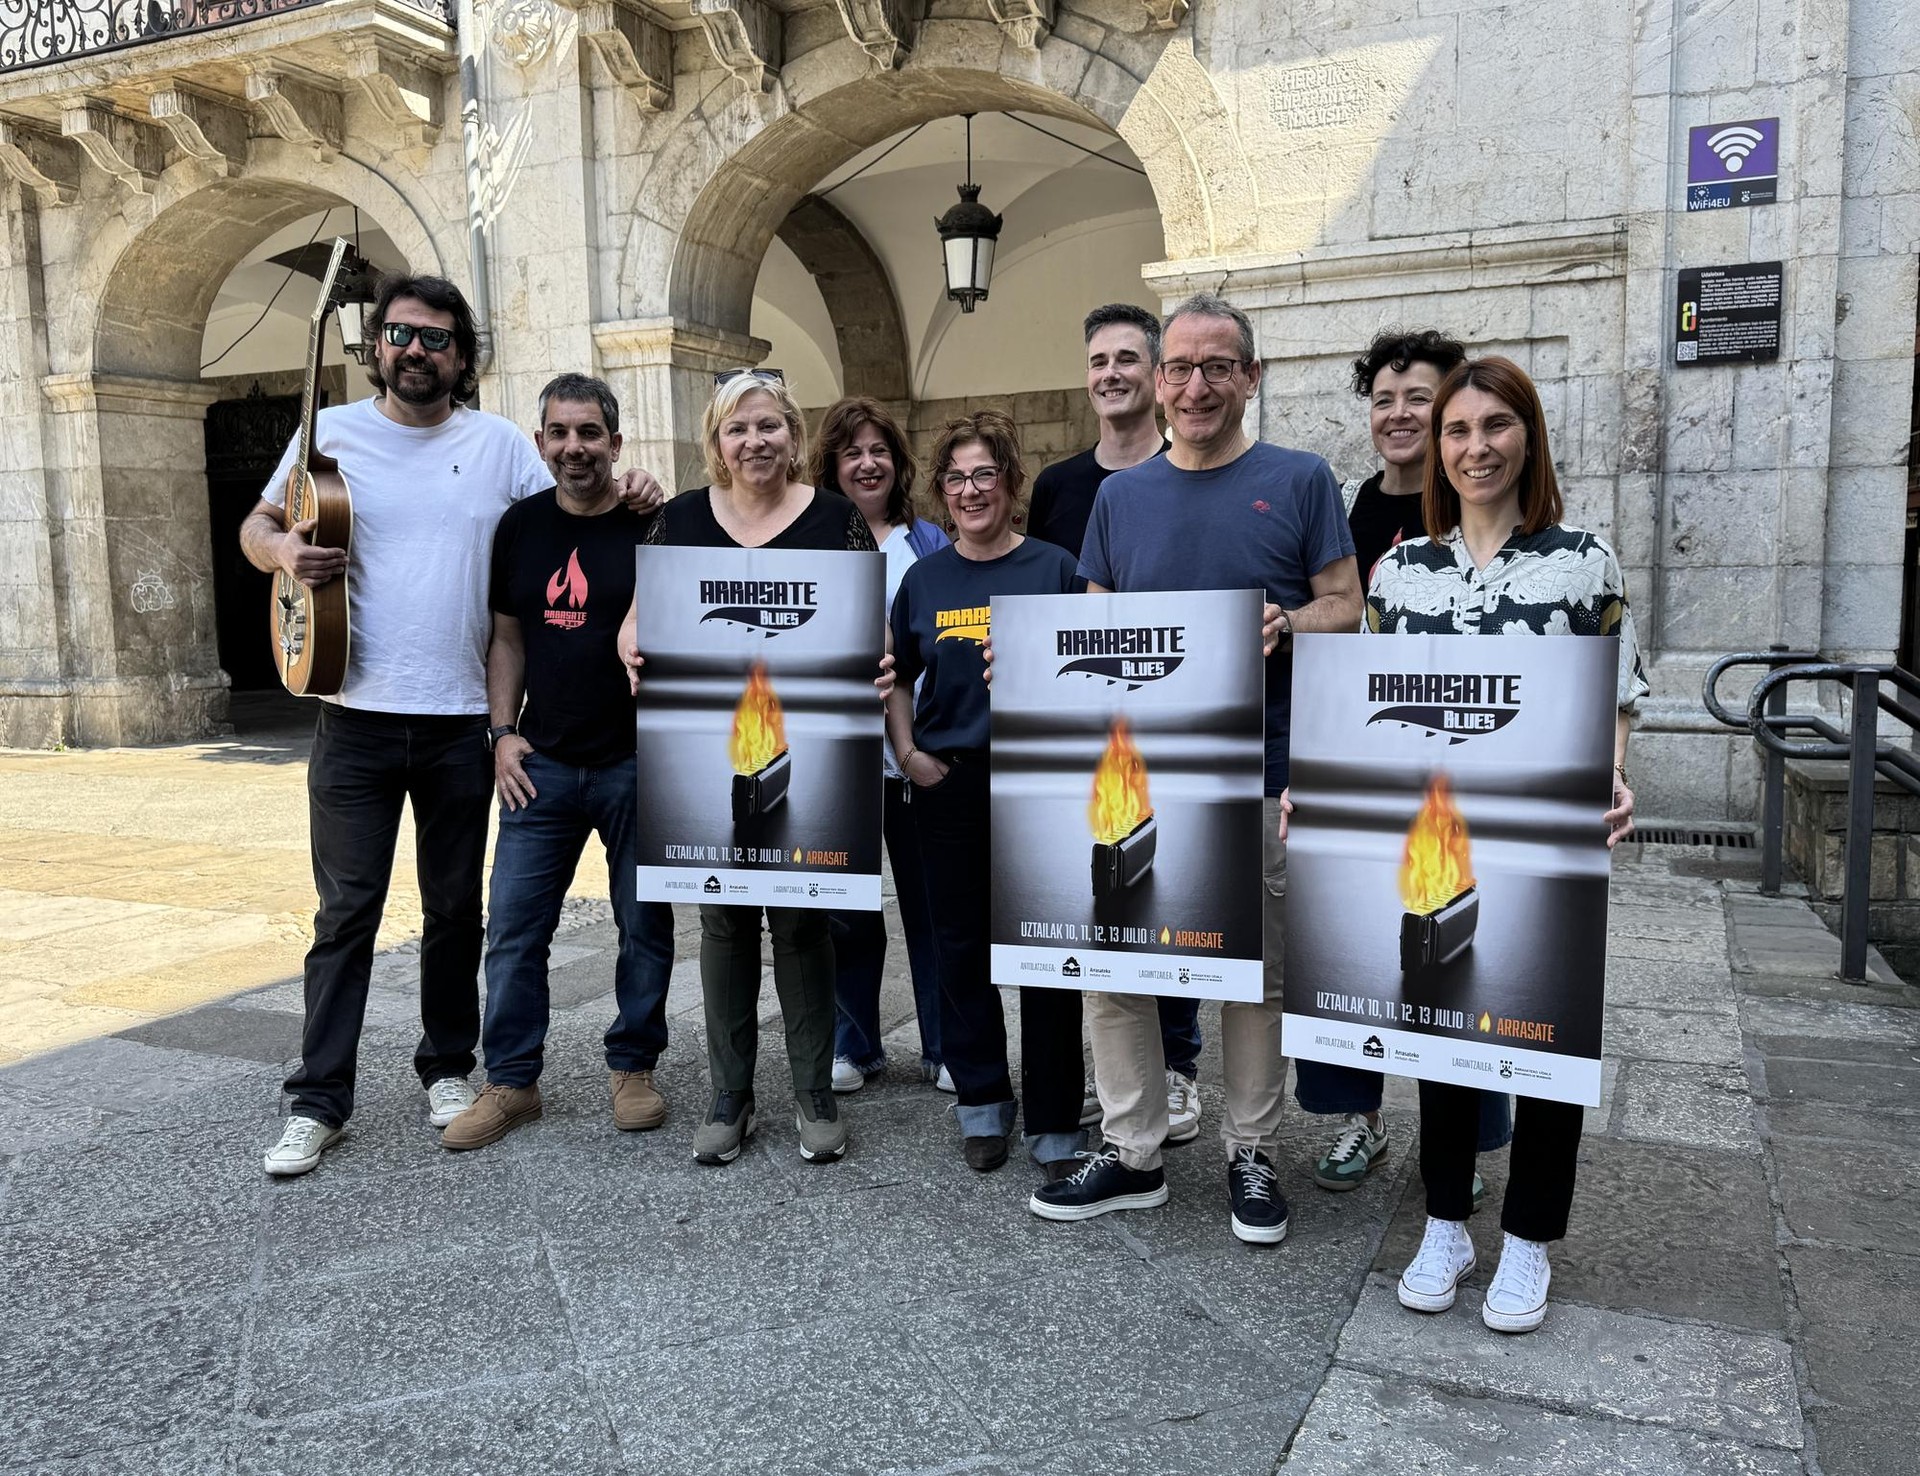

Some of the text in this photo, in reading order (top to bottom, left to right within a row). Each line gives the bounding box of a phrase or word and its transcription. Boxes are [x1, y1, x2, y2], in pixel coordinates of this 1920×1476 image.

[1690, 198, 1730, 210] WiFi4EU
[700, 581, 817, 605] ARRASATE
[544, 610, 587, 620] ARRASATE
[760, 610, 799, 626] BLUES
[1056, 627, 1185, 655] ARRASATE
[1121, 660, 1165, 677] BLUES
[1368, 674, 1521, 704] ARRASATE
[1444, 710, 1495, 729] BLUES
[666, 845, 704, 860] UZTAILAK
[707, 846, 718, 862] 10,
[722, 848, 731, 862] 11,
[734, 848, 744, 863] 12,
[748, 848, 756, 862] 13
[758, 848, 781, 863] JULIO
[806, 850, 848, 866] ARRASATE
[1021, 921, 1063, 939] UZTAILAK
[1065, 924, 1078, 942] 10,
[1081, 925, 1091, 943] 11,
[1094, 925, 1106, 944] 12,
[1110, 926, 1119, 943] 13
[1121, 926, 1146, 944] JULIO
[1175, 930, 1223, 948] ARRASATE
[1316, 991, 1364, 1015] UZTAILAK
[1368, 999, 1382, 1018] 10,
[1386, 1001, 1397, 1021] 11,
[1402, 1003, 1415, 1023] 12,
[1420, 1006, 1430, 1024] 13
[1434, 1008, 1463, 1029] JULIO
[1497, 1018, 1555, 1043] ARRASATE
